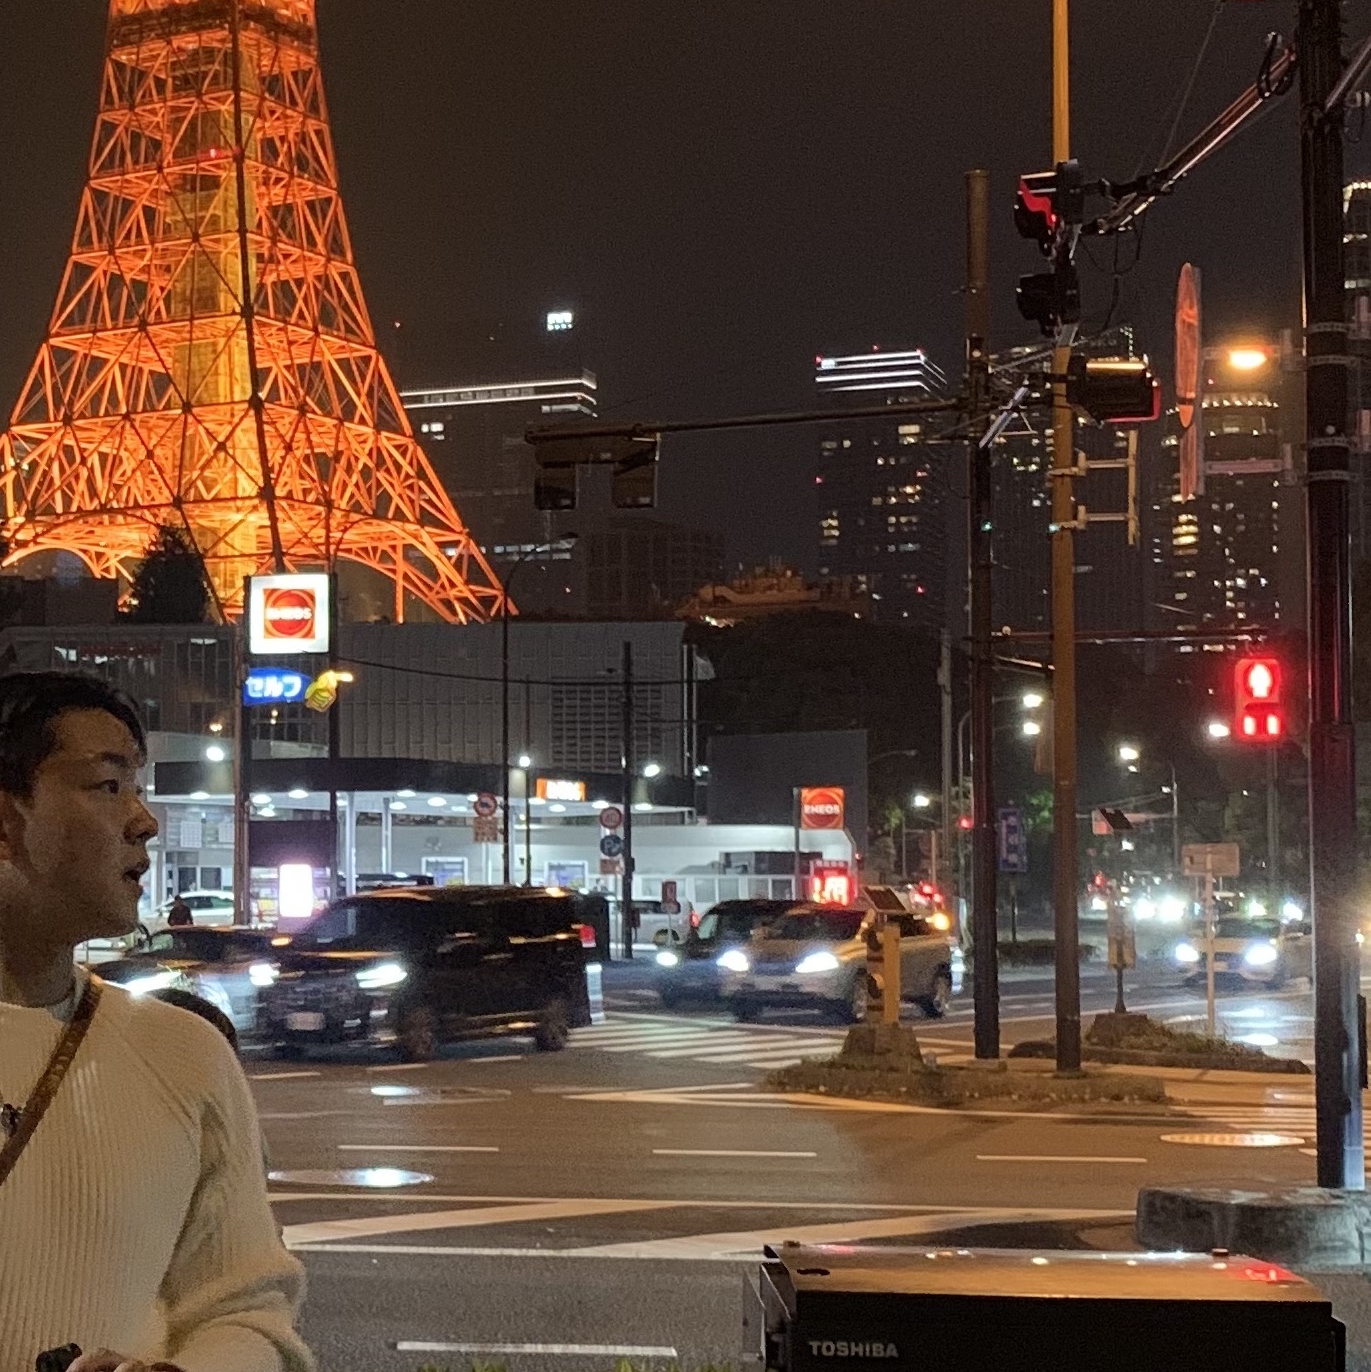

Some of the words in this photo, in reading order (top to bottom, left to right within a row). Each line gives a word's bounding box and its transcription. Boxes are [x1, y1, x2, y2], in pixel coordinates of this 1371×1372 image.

[246, 676, 302, 698] セルフ
[804, 804, 840, 815] ENEOS
[809, 1341, 899, 1358] TOSHIBA
